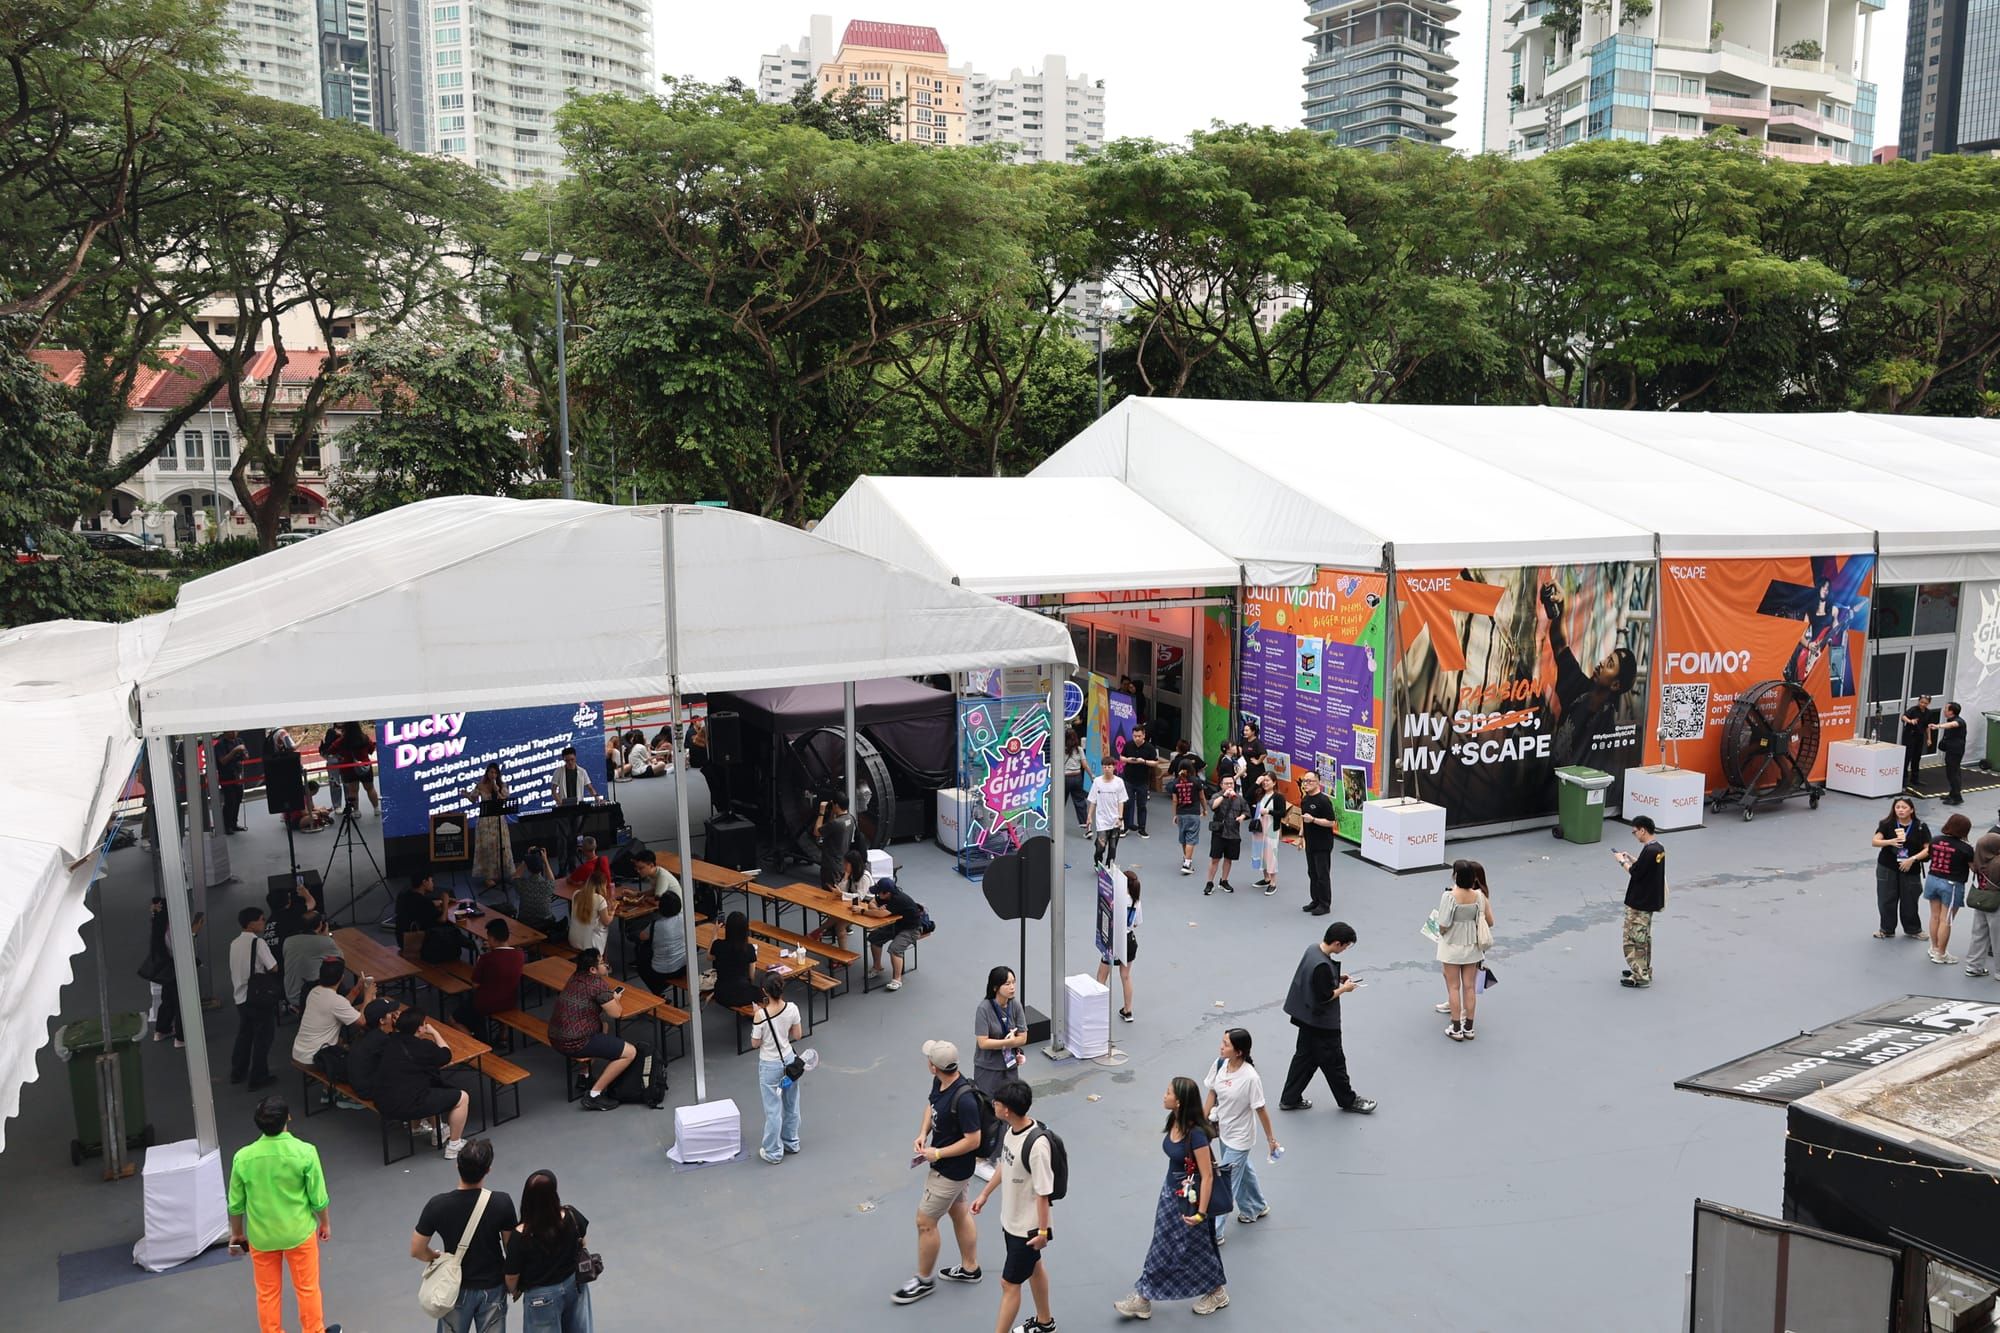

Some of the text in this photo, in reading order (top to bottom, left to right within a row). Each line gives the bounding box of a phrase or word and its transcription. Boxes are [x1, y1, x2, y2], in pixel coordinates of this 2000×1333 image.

[1284, 586, 1336, 611] Month
[1664, 650, 1751, 675] FOMO?
[1459, 678, 1543, 708] PASSION
[1712, 692, 1733, 702] Scan
[1711, 706, 1722, 714] on
[384, 711, 467, 746] Lucky
[1404, 711, 1448, 741] My
[395, 736, 467, 769] Draw
[414, 731, 573, 781] Participate in the Digital Tapestry
[1005, 751, 1031, 773] It's
[1402, 745, 1447, 775] My
[422, 775, 457, 792] and/or
[503, 749, 553, 770] Telematch
[429, 786, 458, 803] stand
[501, 774, 513, 783] to
[512, 767, 531, 780] win
[531, 760, 566, 775] amazin
[989, 769, 1048, 795] Giving
[508, 778, 543, 794] Lenovo
[522, 791, 541, 805] gift
[1001, 788, 1037, 810] Fest
[1860, 1040, 1922, 1065] your
[1733, 1056, 1829, 1094] content
